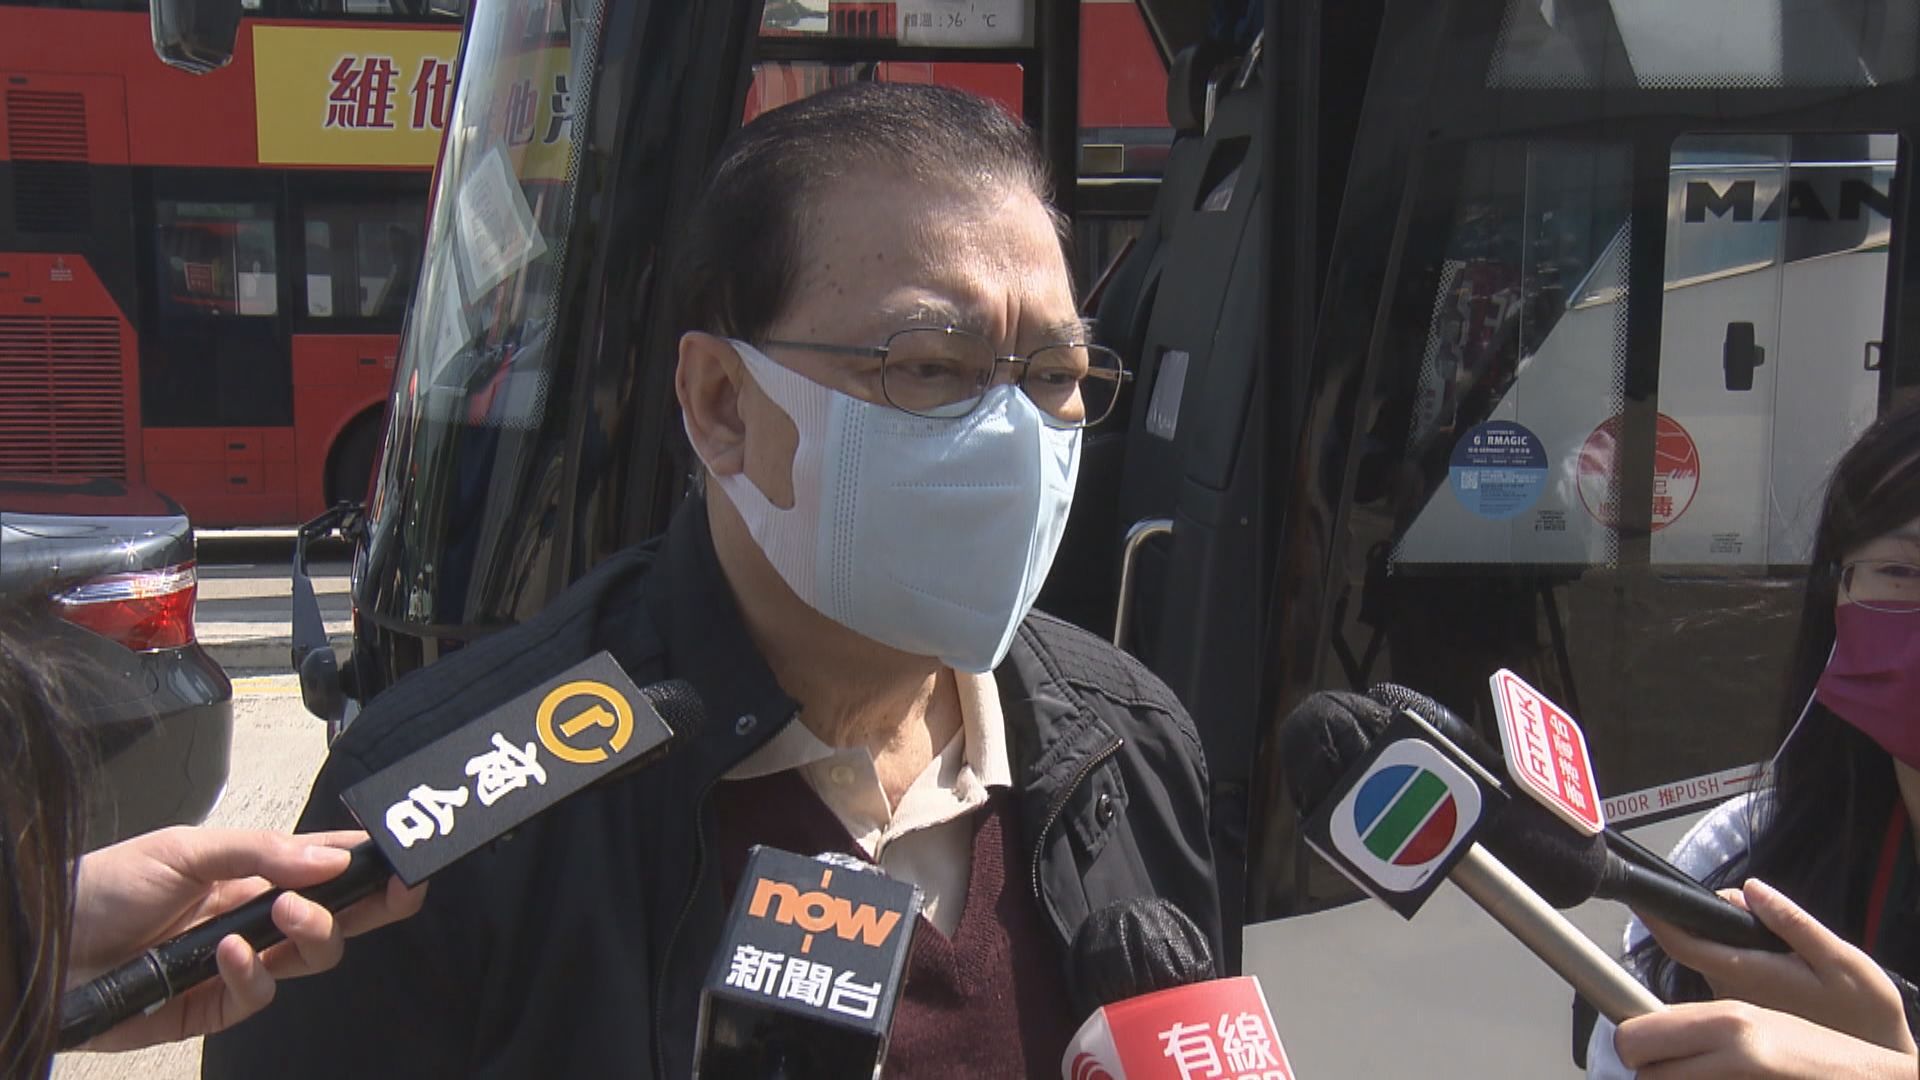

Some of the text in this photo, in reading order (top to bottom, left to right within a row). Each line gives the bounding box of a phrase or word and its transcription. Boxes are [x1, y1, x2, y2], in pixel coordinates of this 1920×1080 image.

[1685, 180, 1892, 222] MAN
[1474, 436, 1528, 446] GRMAGIC
[1515, 687, 1550, 783] RTHK
[385, 732, 547, 848] 商台
[1605, 794, 1649, 820] DOOR
[748, 876, 902, 948] now
[726, 944, 883, 1019] 新聞台
[1158, 1011, 1279, 1080] 有線
